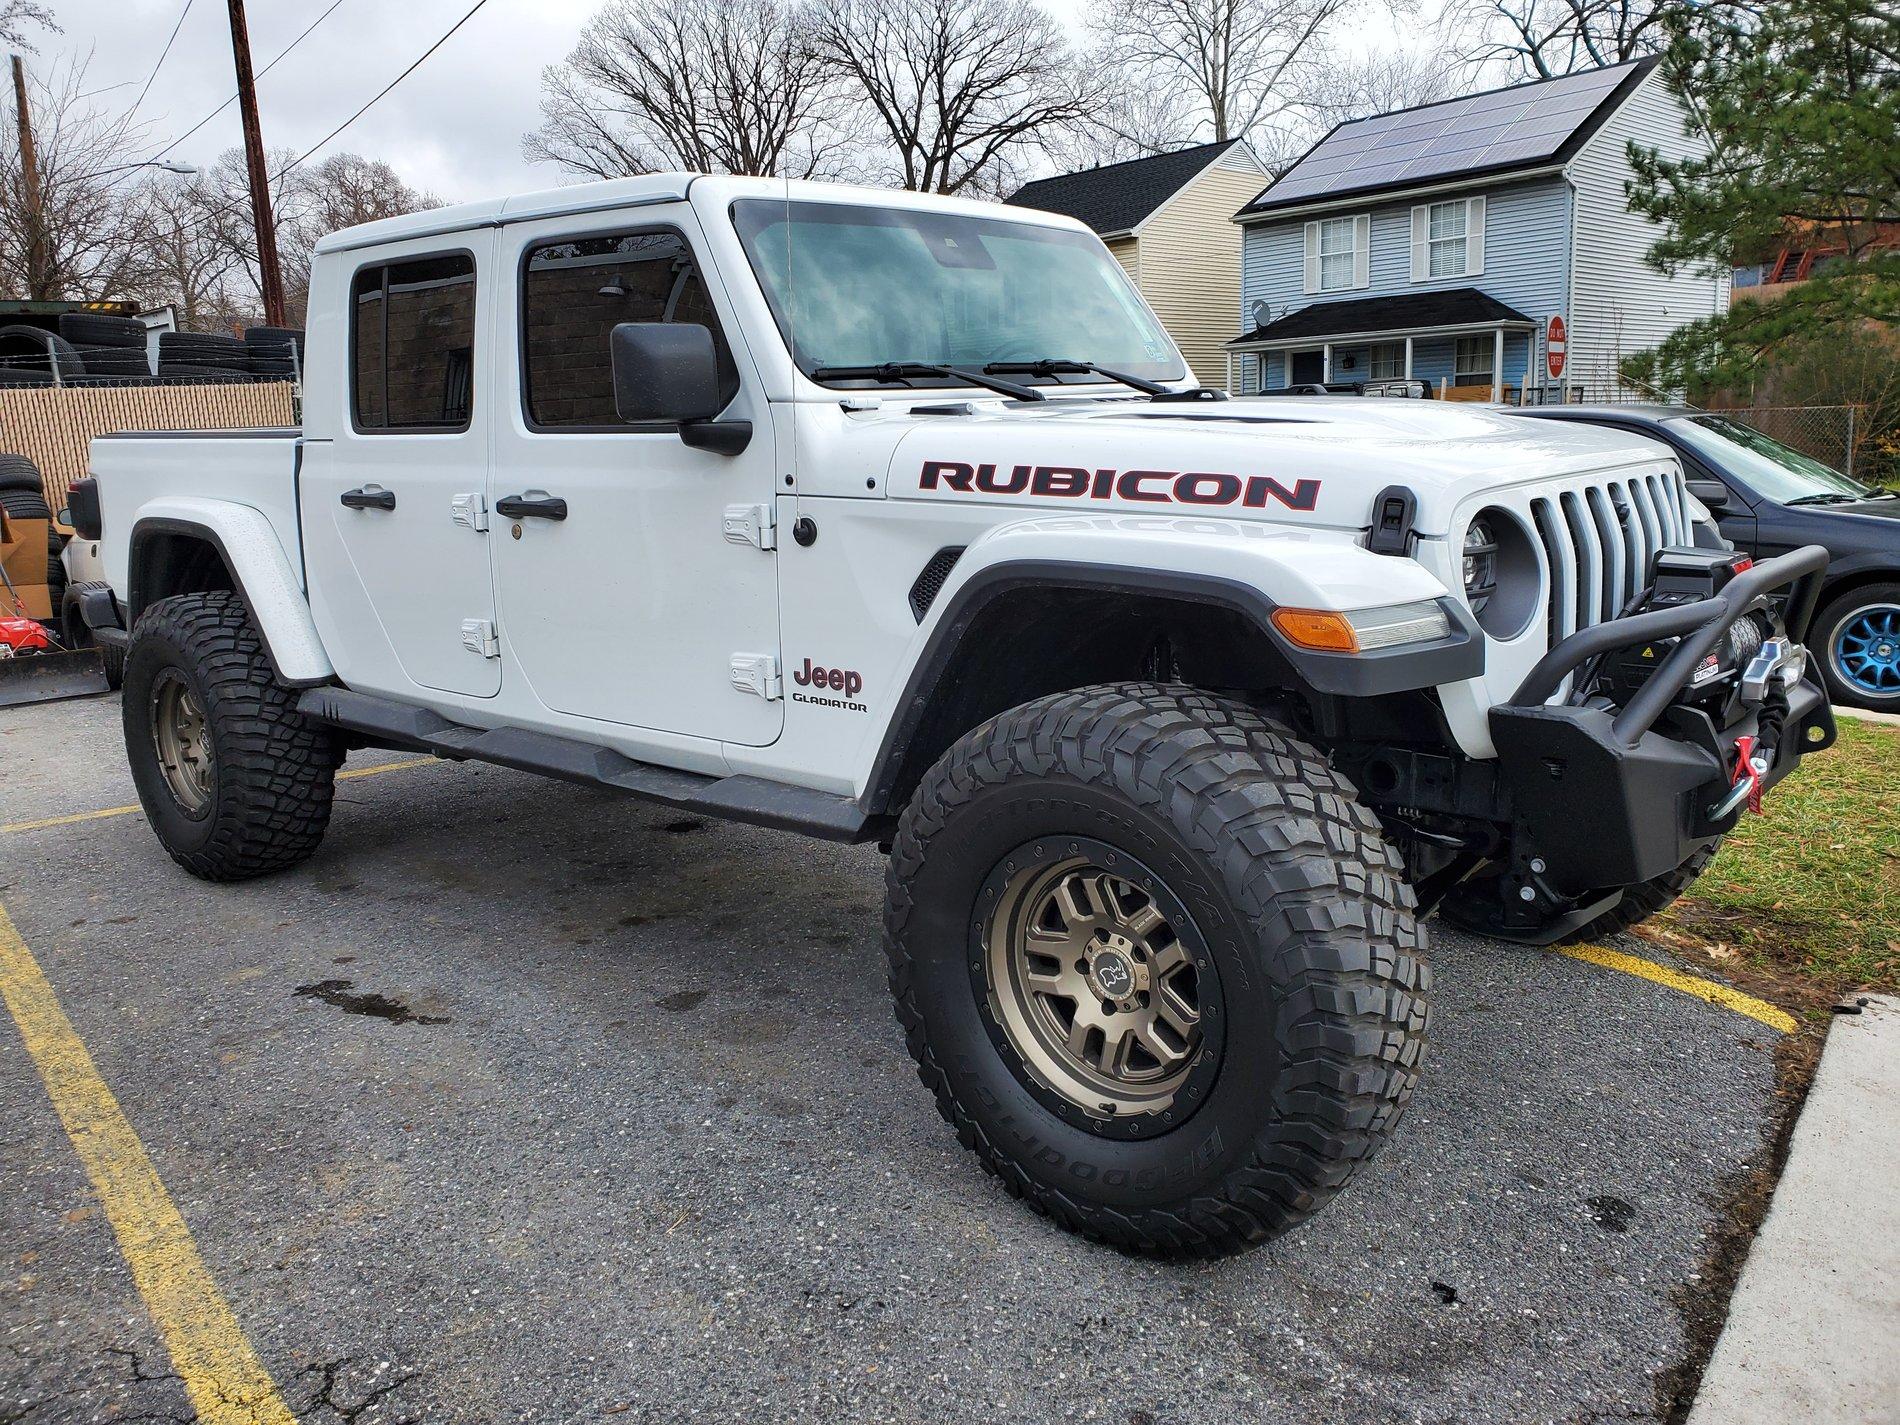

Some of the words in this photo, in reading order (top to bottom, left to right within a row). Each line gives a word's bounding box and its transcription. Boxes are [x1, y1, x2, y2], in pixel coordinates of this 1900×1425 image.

[1550, 328, 1556, 338] DO
[1556, 328, 1564, 339] NOT
[1550, 356, 1562, 366] ENTER
[919, 460, 1323, 511] RUBICON
[793, 657, 863, 699] Jeep
[792, 692, 868, 713] GLADIATOR
